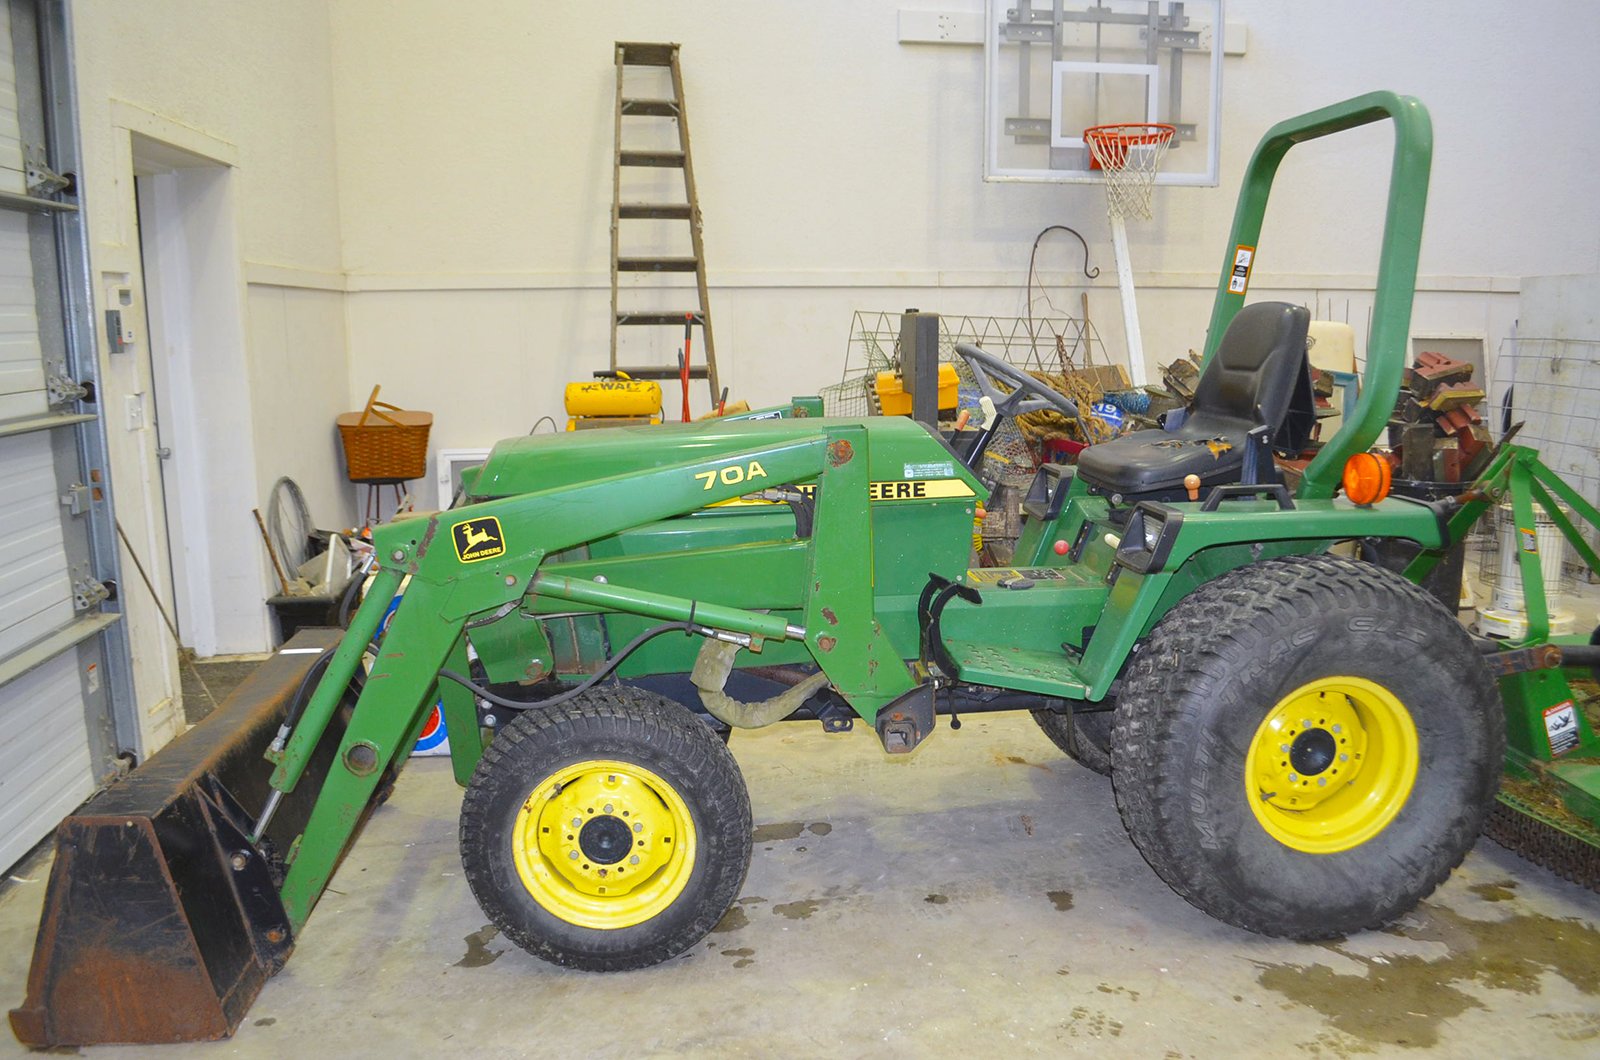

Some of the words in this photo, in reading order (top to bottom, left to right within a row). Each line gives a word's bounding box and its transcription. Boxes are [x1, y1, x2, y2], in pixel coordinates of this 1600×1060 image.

[694, 460, 768, 491] 70A
[870, 482, 926, 498] EERE
[462, 551, 480, 560] JOHN
[480, 546, 501, 556] DEERE
